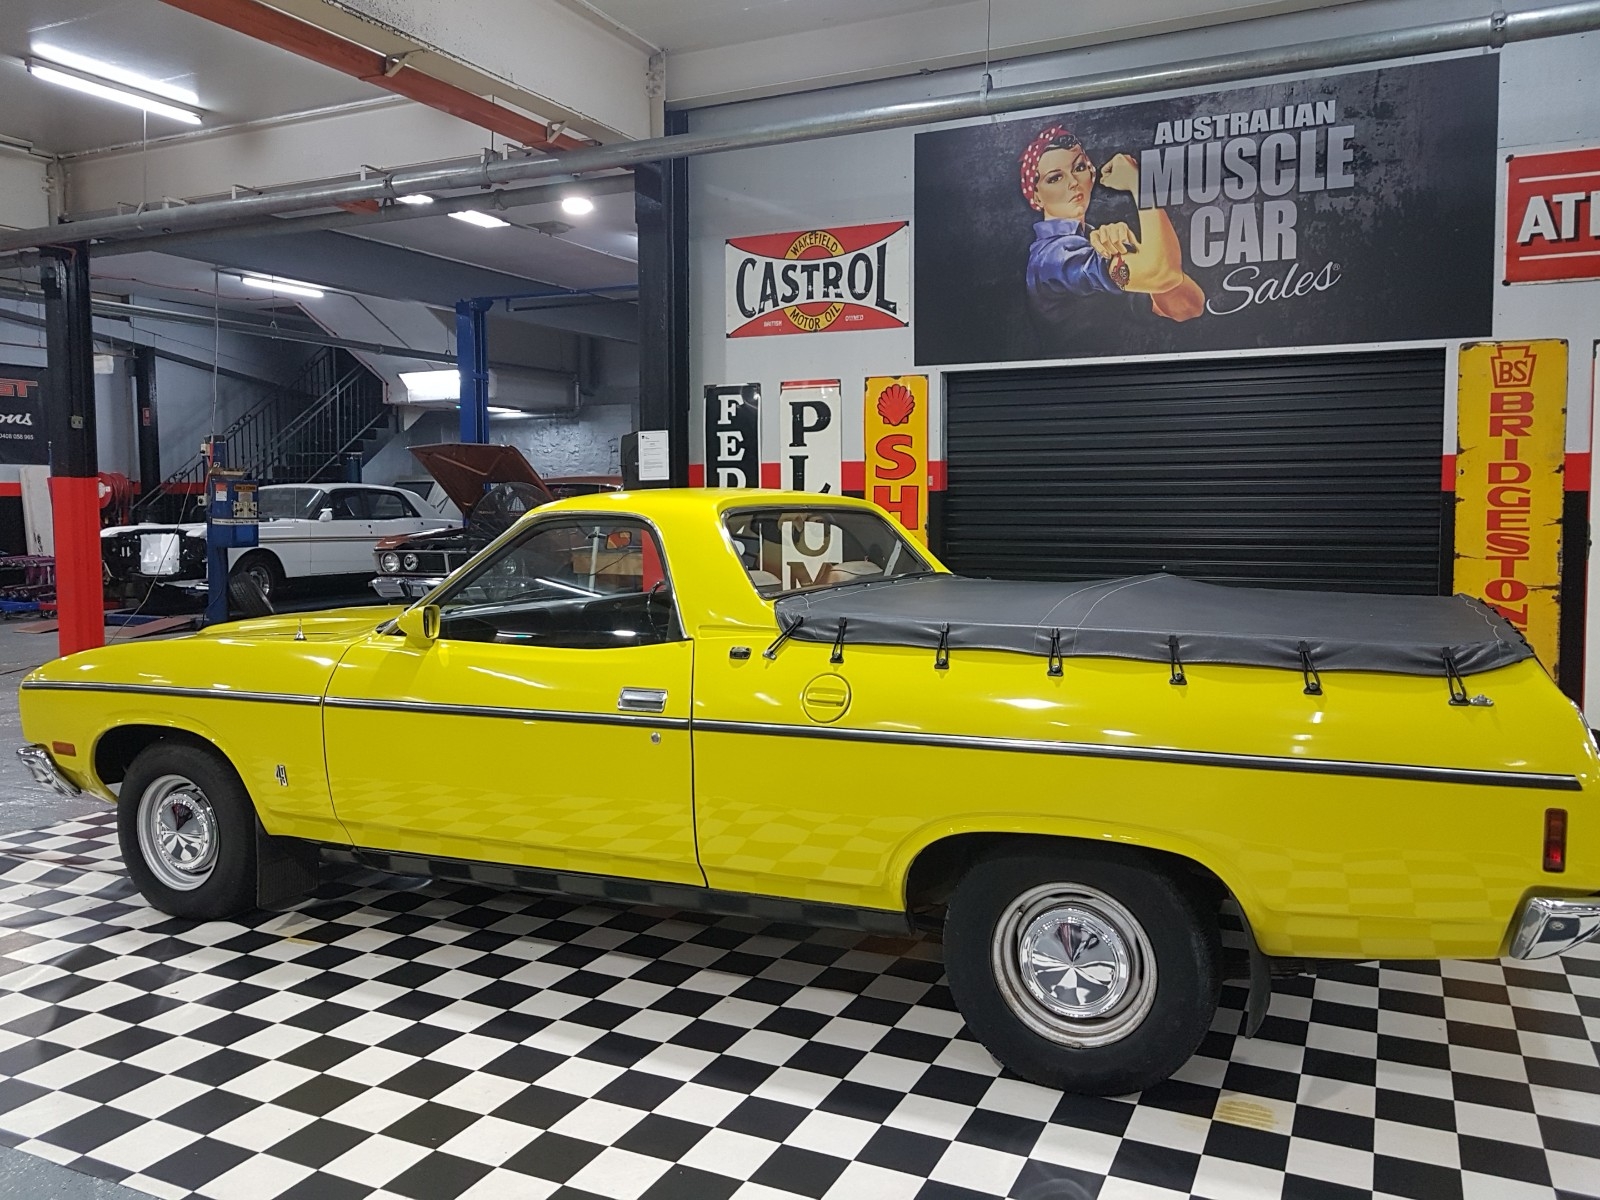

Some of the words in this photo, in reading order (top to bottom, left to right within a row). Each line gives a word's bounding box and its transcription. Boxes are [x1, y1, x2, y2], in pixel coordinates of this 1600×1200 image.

[1154, 99, 1336, 145] AUSTRALIAN
[1139, 125, 1355, 209] MUSCLE
[790, 232, 838, 256] WAKEFIELD
[1190, 199, 1297, 268] CAR
[735, 242, 897, 319] CASTROL
[1206, 261, 1341, 315] Sales
[790, 309, 821, 330] MOTOR
[824, 305, 841, 321] OIL
[1498, 360, 1528, 383] BS
